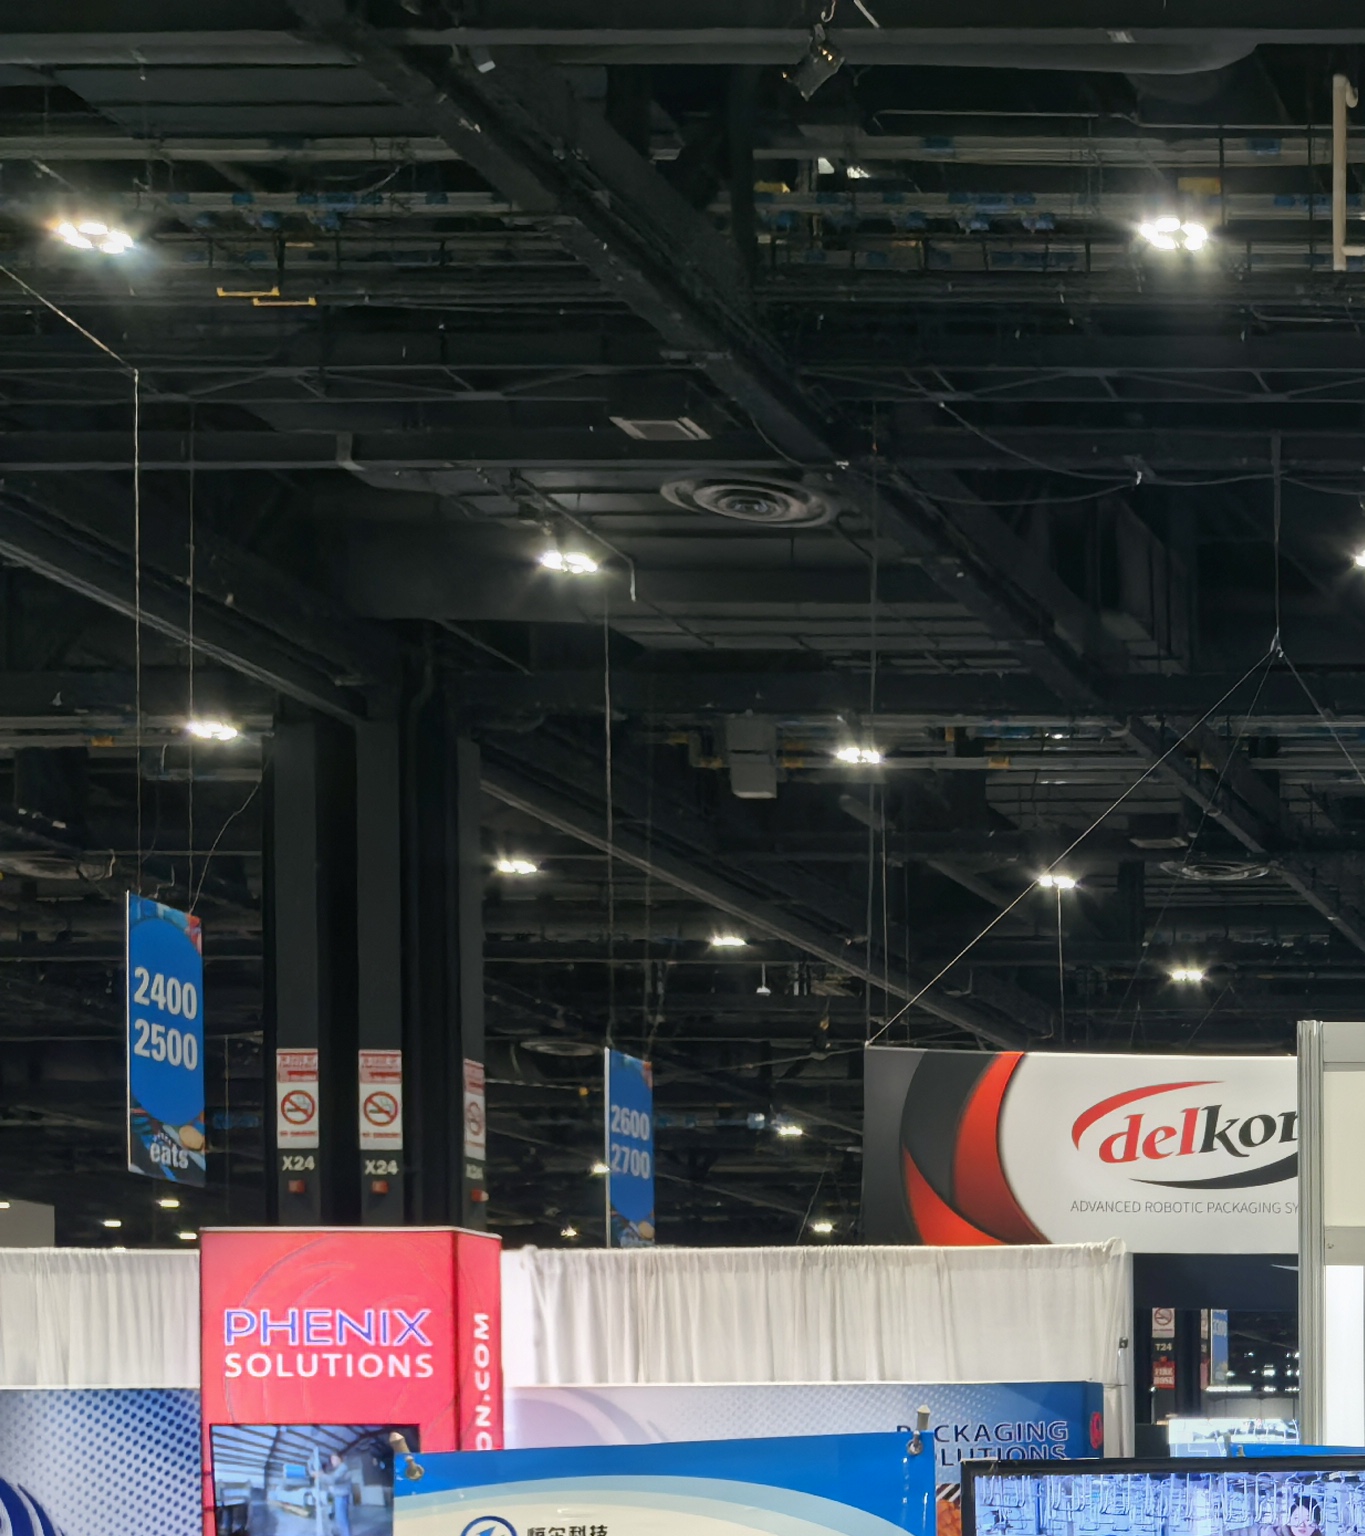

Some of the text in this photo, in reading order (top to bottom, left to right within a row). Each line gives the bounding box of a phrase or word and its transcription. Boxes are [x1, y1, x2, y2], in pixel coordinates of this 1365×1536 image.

[134, 966, 197, 1020] 2400
[134, 1018, 198, 1071] 2500
[611, 1104, 650, 1141] 2600
[150, 1141, 189, 1169] eats
[282, 1156, 315, 1171] X24
[365, 1160, 399, 1175] X24
[612, 1144, 650, 1180] 2700
[1070, 1200, 1141, 1213] ADVANCED
[1145, 1201, 1203, 1213] ROBOTIC
[1207, 1202, 1282, 1214] PACKAGING
[224, 1309, 433, 1347] PHENIX
[1155, 1343, 1173, 1351] T24
[225, 1353, 434, 1378] SOLUTIONS
[897, 1420, 1068, 1443] CKAGING
